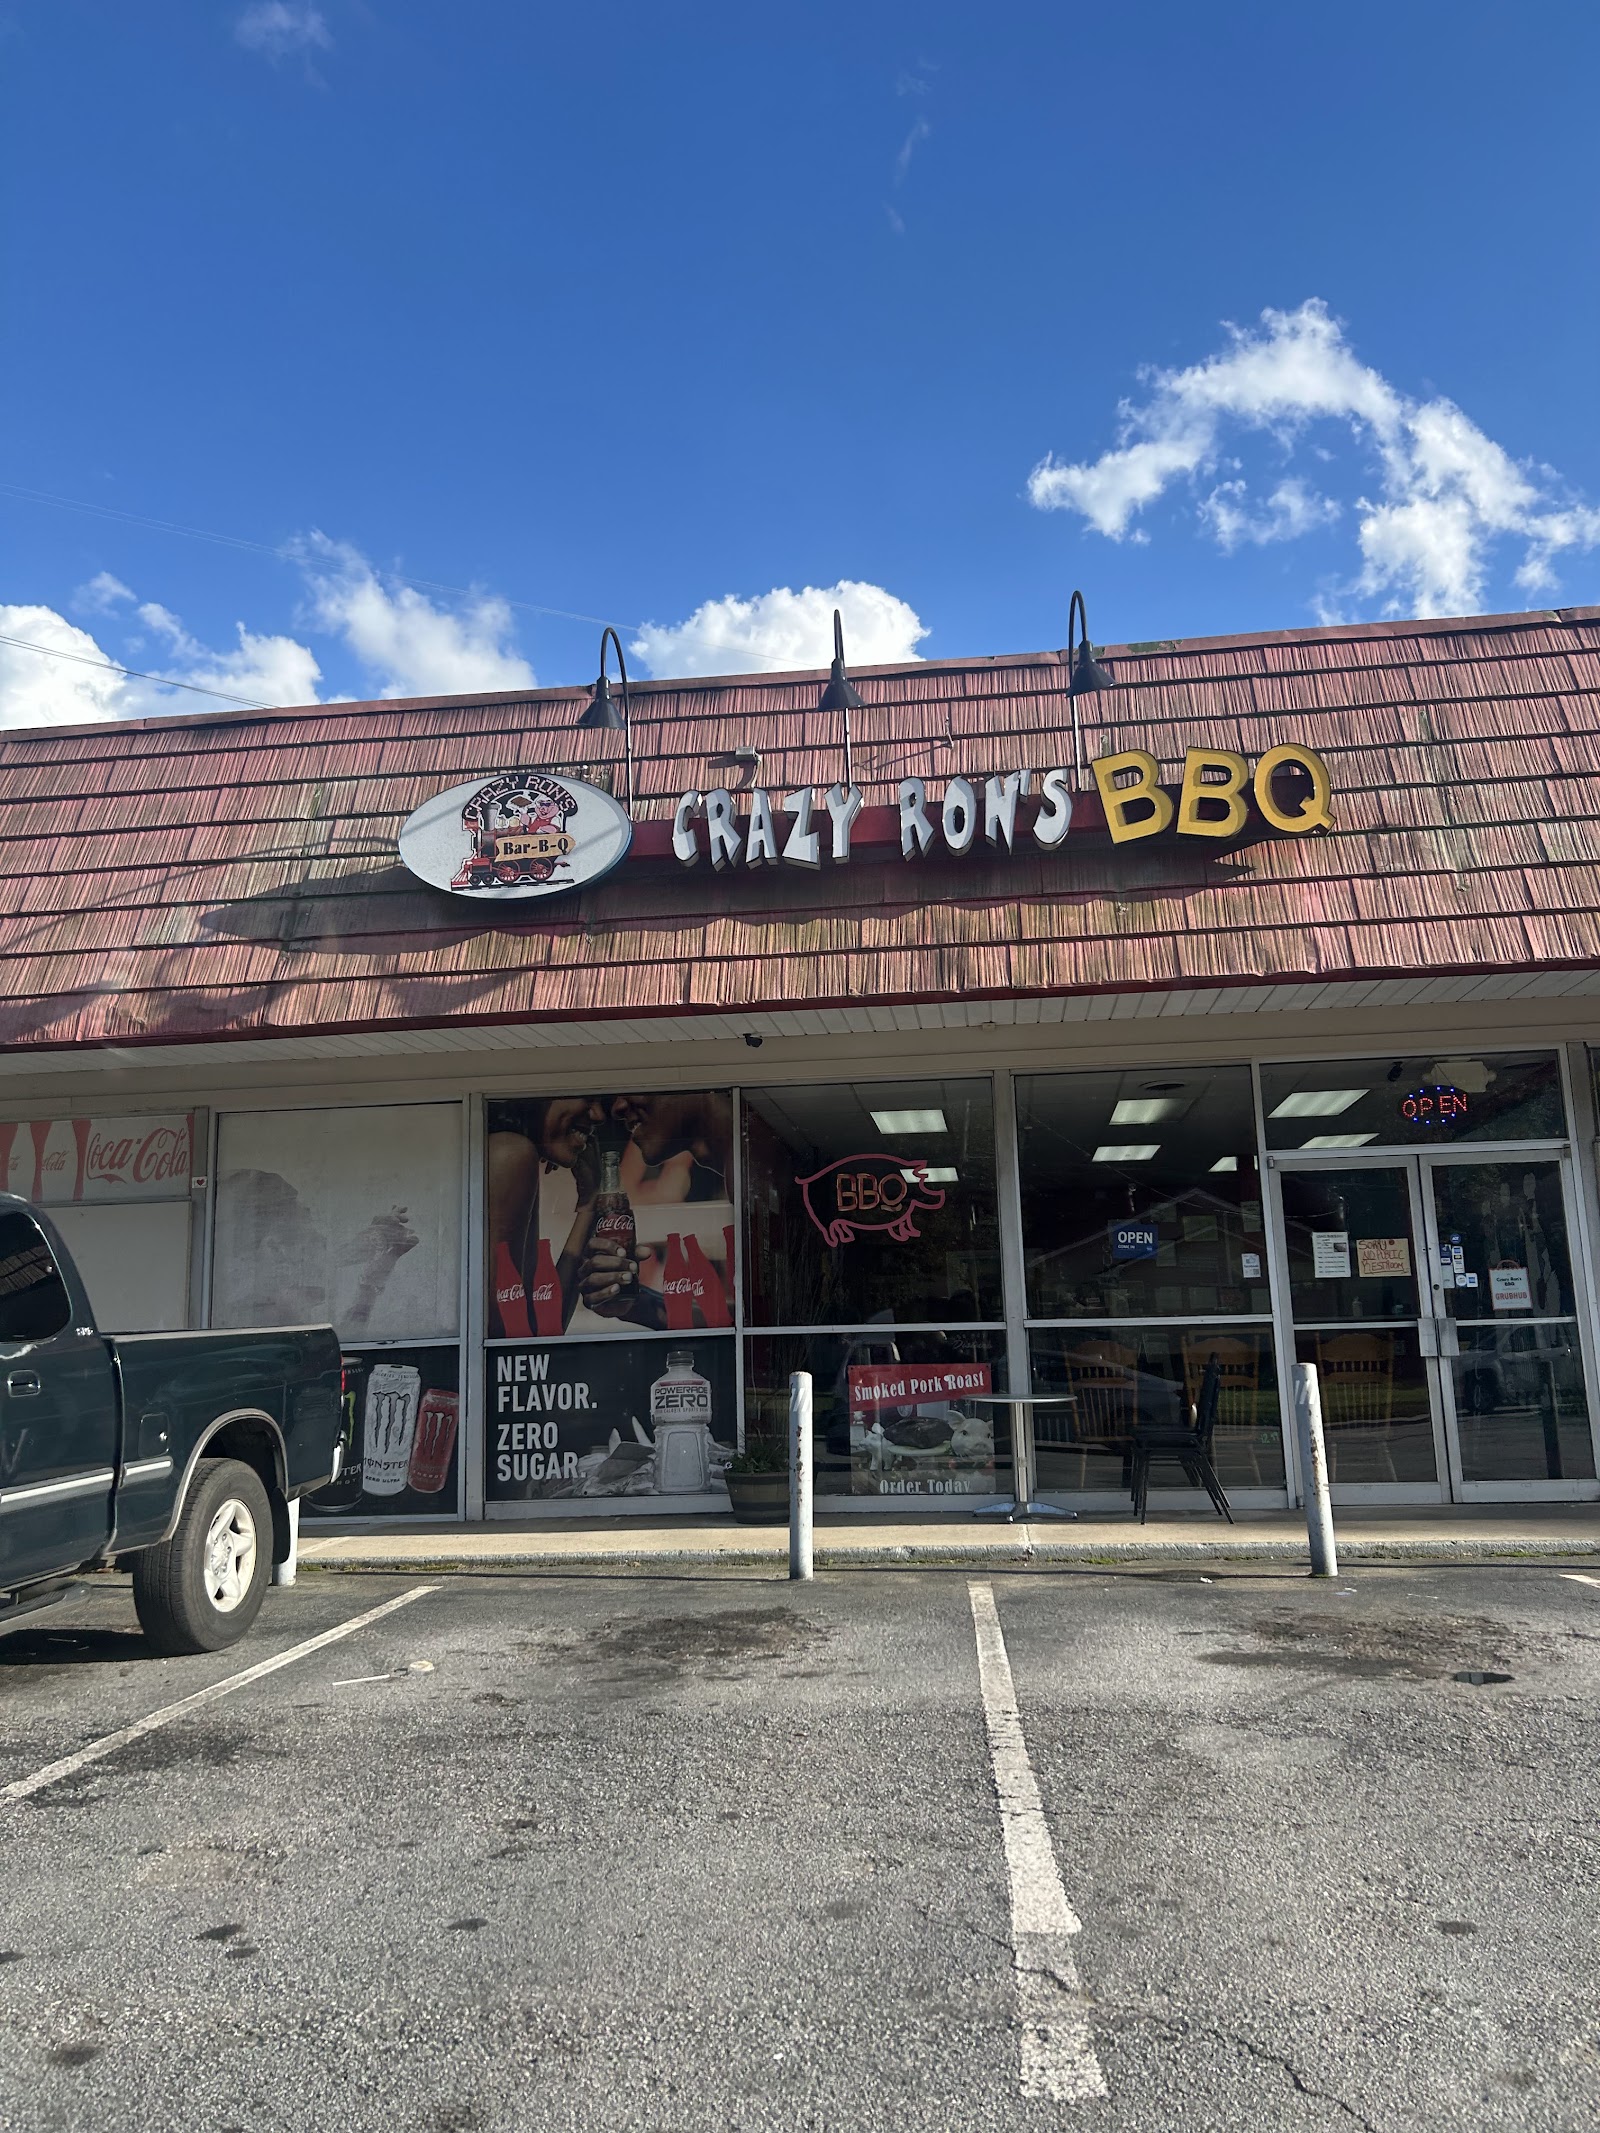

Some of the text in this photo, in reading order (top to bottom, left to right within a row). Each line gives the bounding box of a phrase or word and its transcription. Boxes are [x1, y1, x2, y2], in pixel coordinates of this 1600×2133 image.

[464, 775, 575, 819] CRAZY RON'S
[672, 743, 1339, 870] CRAZY RON'S BBQ
[503, 837, 569, 855] Bar-B-Q
[1402, 1093, 1468, 1117] OPEN
[86, 1127, 188, 1184] Coca-Cola
[837, 1173, 907, 1212] BBQ
[1117, 1231, 1153, 1244] OPEN
[1359, 1240, 1387, 1250] SORRY
[1377, 1250, 1404, 1260] PUBLIC
[1495, 1291, 1528, 1300] GRUBHUB
[497, 1354, 549, 1382] NEW
[498, 1382, 598, 1412] FLAVOR.
[655, 1386, 708, 1395] POWERADE
[854, 1371, 985, 1402] Smoked Pork Roast
[655, 1394, 708, 1409] ZERO
[497, 1422, 558, 1450] ZERO
[497, 1452, 587, 1481] SUGAR.
[879, 1479, 971, 1494] Order Today
